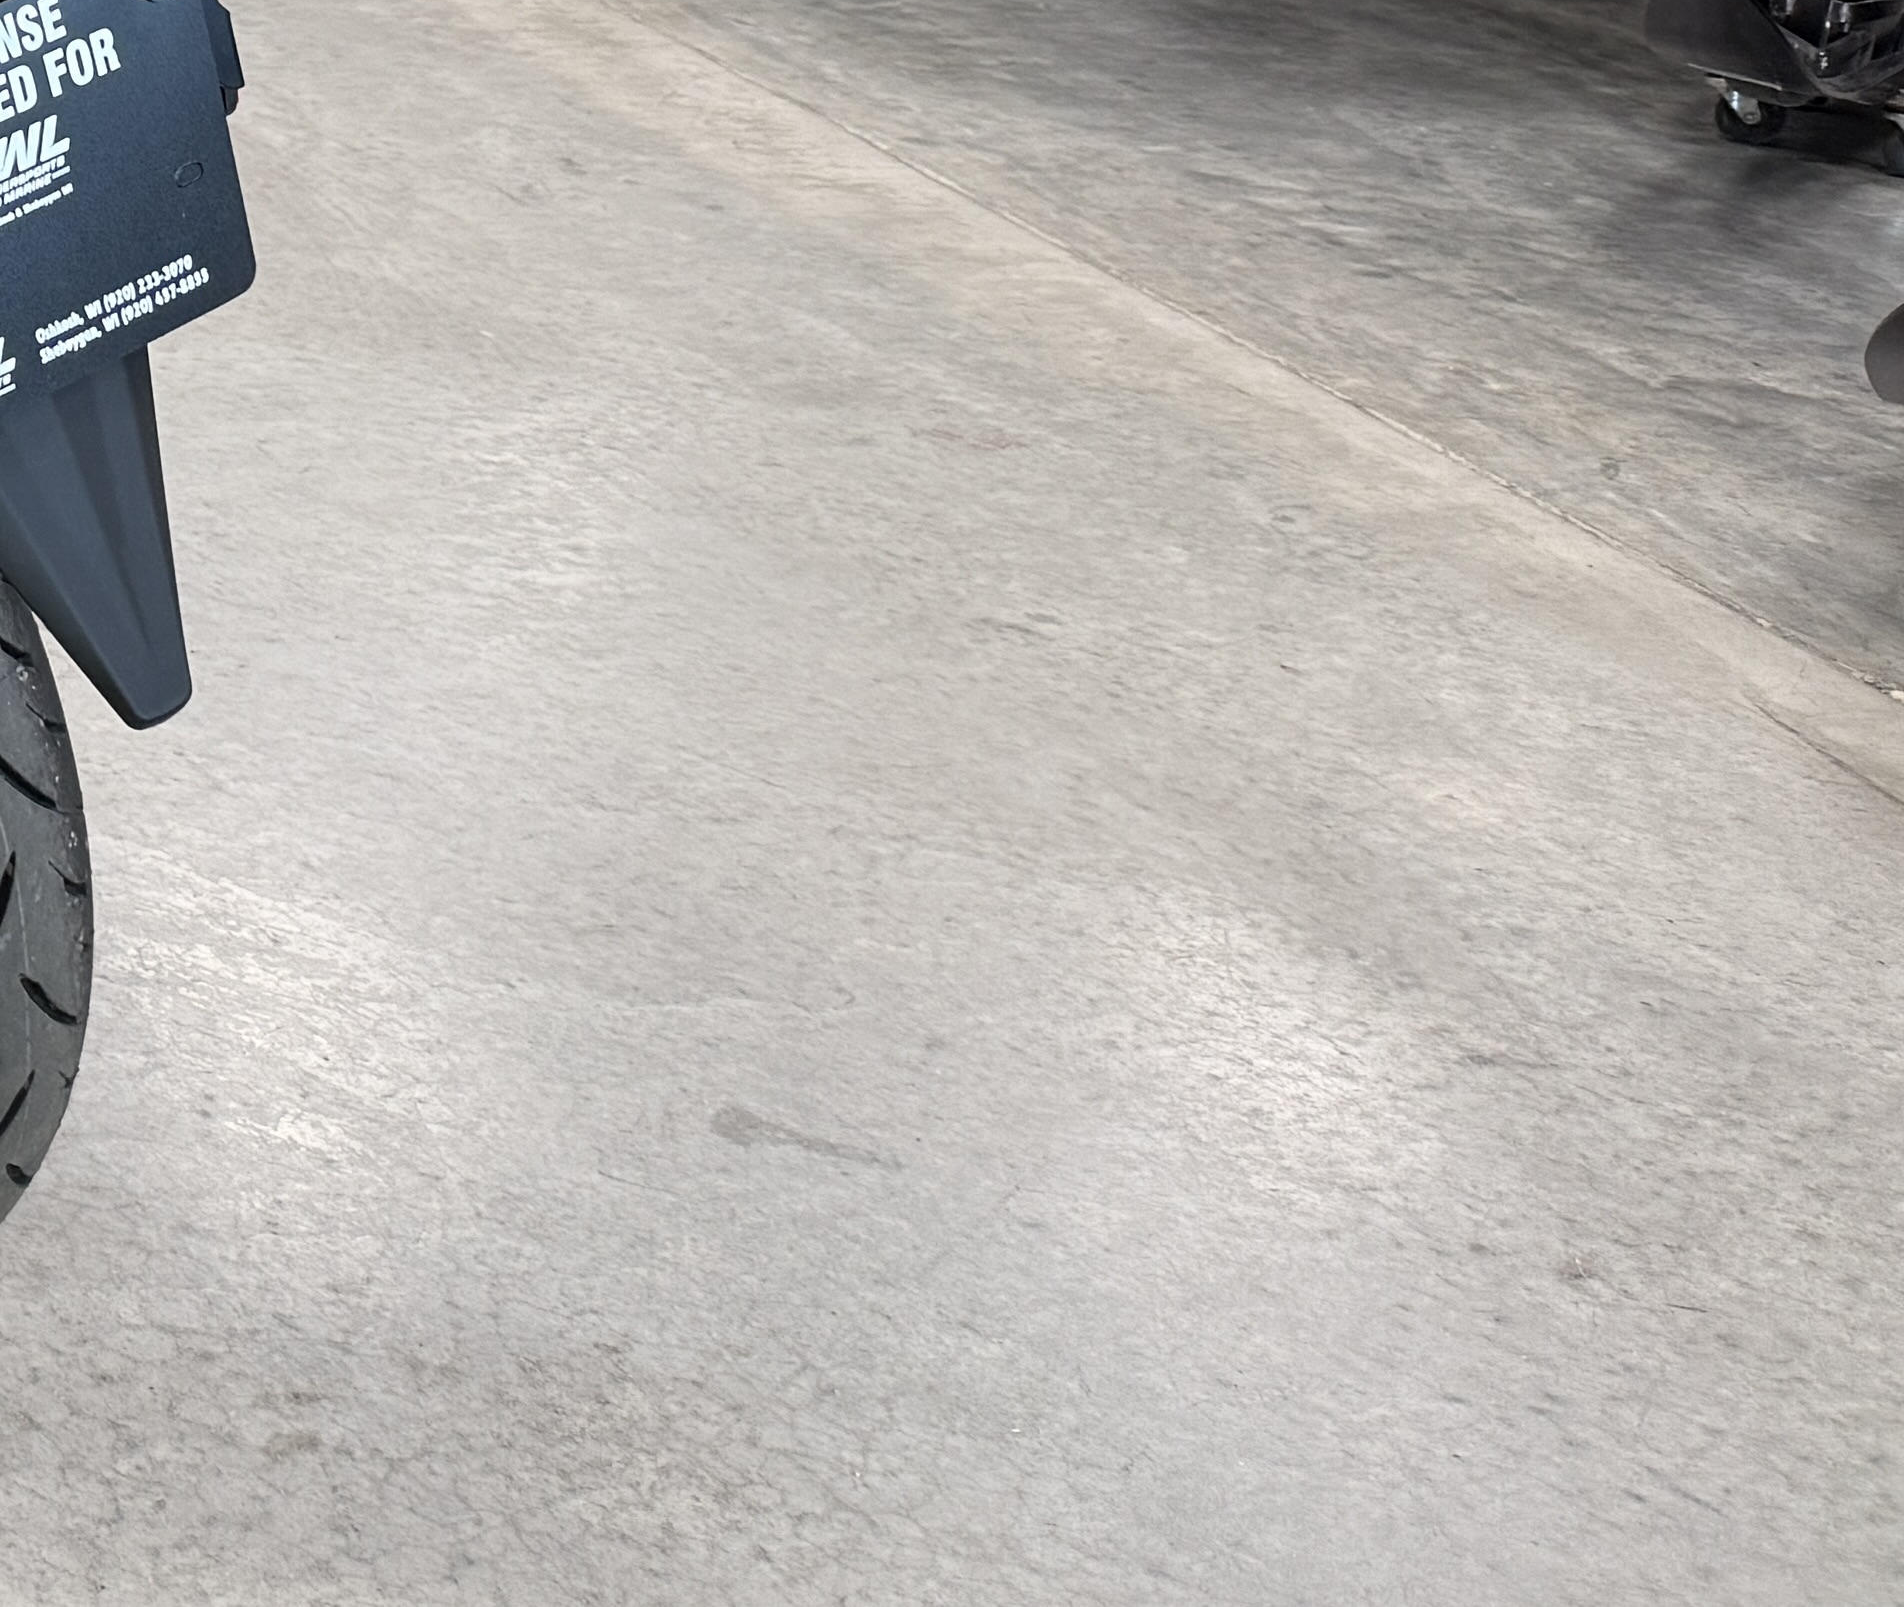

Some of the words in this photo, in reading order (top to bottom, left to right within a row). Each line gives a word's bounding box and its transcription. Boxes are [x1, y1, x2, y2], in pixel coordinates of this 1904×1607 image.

[42, 27, 121, 98] FOR
[3, 173, 52, 205] MARINE
[84, 299, 103, 320] WI
[103, 282, 136, 313] (920)
[102, 313, 121, 332] WI
[121, 295, 154, 326] (920)
